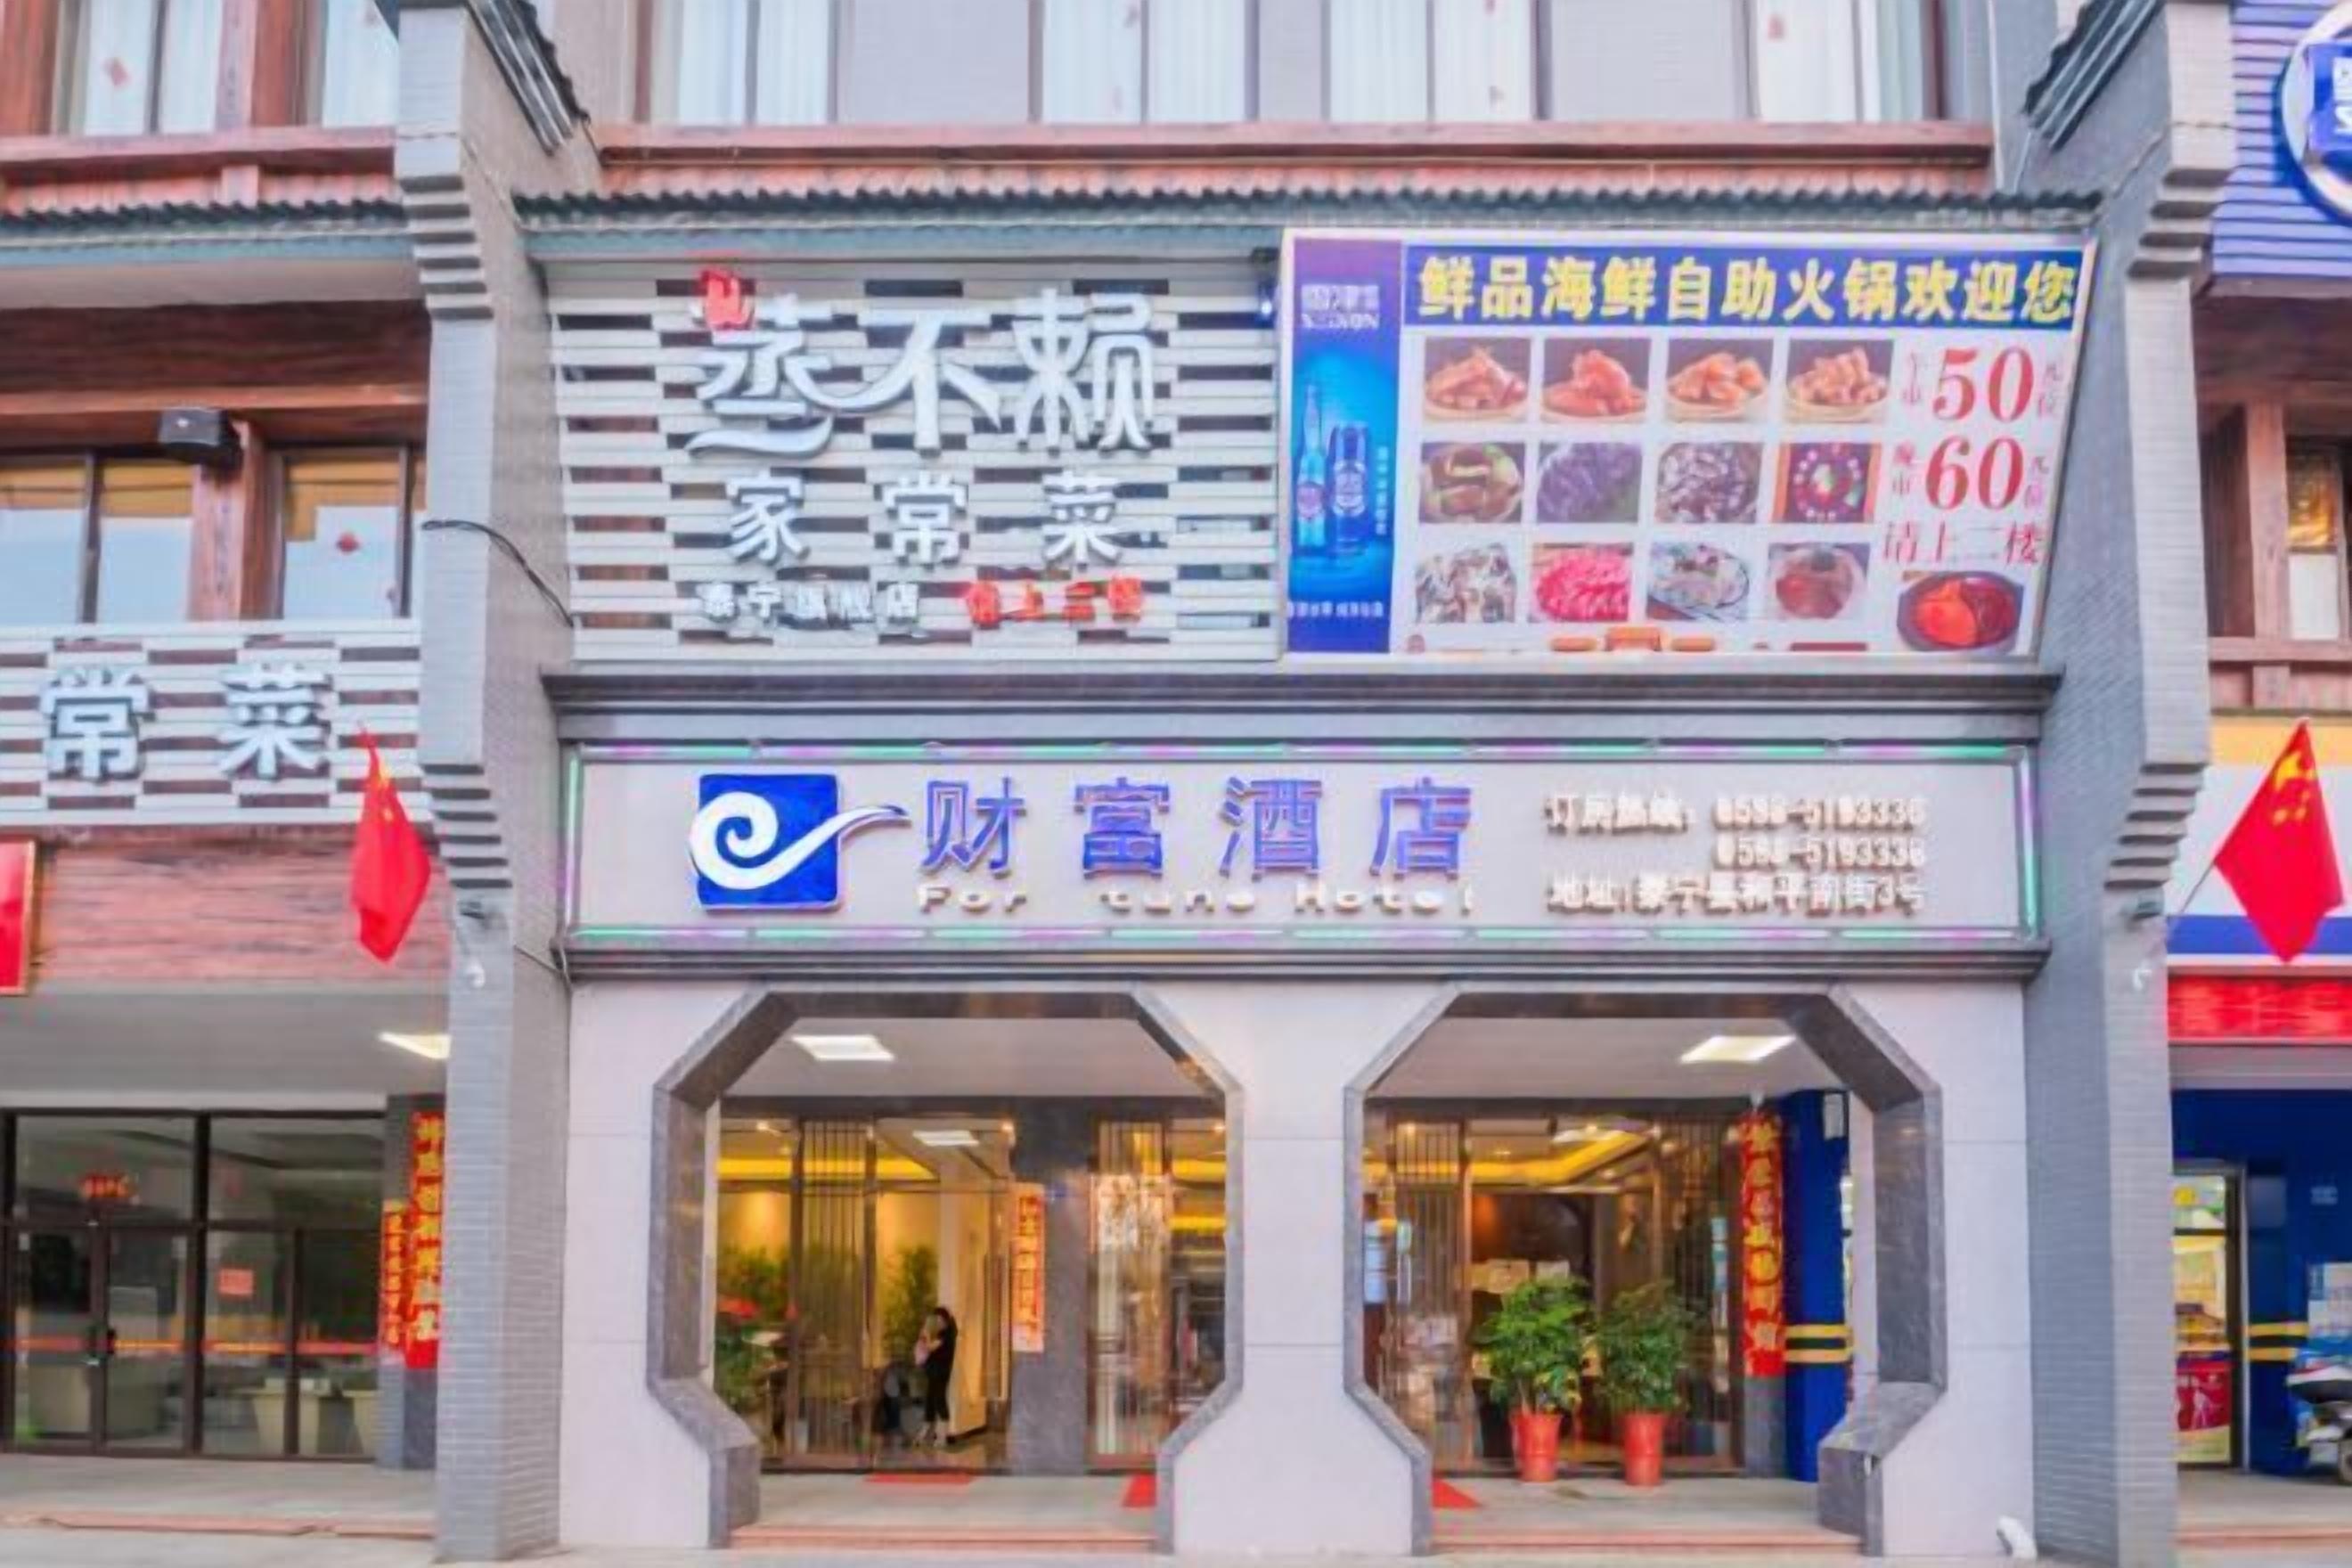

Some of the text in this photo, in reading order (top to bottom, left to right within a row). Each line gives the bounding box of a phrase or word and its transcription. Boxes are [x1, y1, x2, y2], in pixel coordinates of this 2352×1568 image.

[1417, 255, 2078, 324] 鲜品海鲜自助火锅欢迎您
[685, 278, 1156, 458] 蒸不赖
[1932, 345, 2035, 423] 50
[1925, 435, 2025, 511] 60
[725, 468, 1124, 568] 家常菜
[39, 663, 334, 782] 常菜
[921, 774, 1475, 881] 财富酒店
[1294, 880, 1476, 917] Hotel
